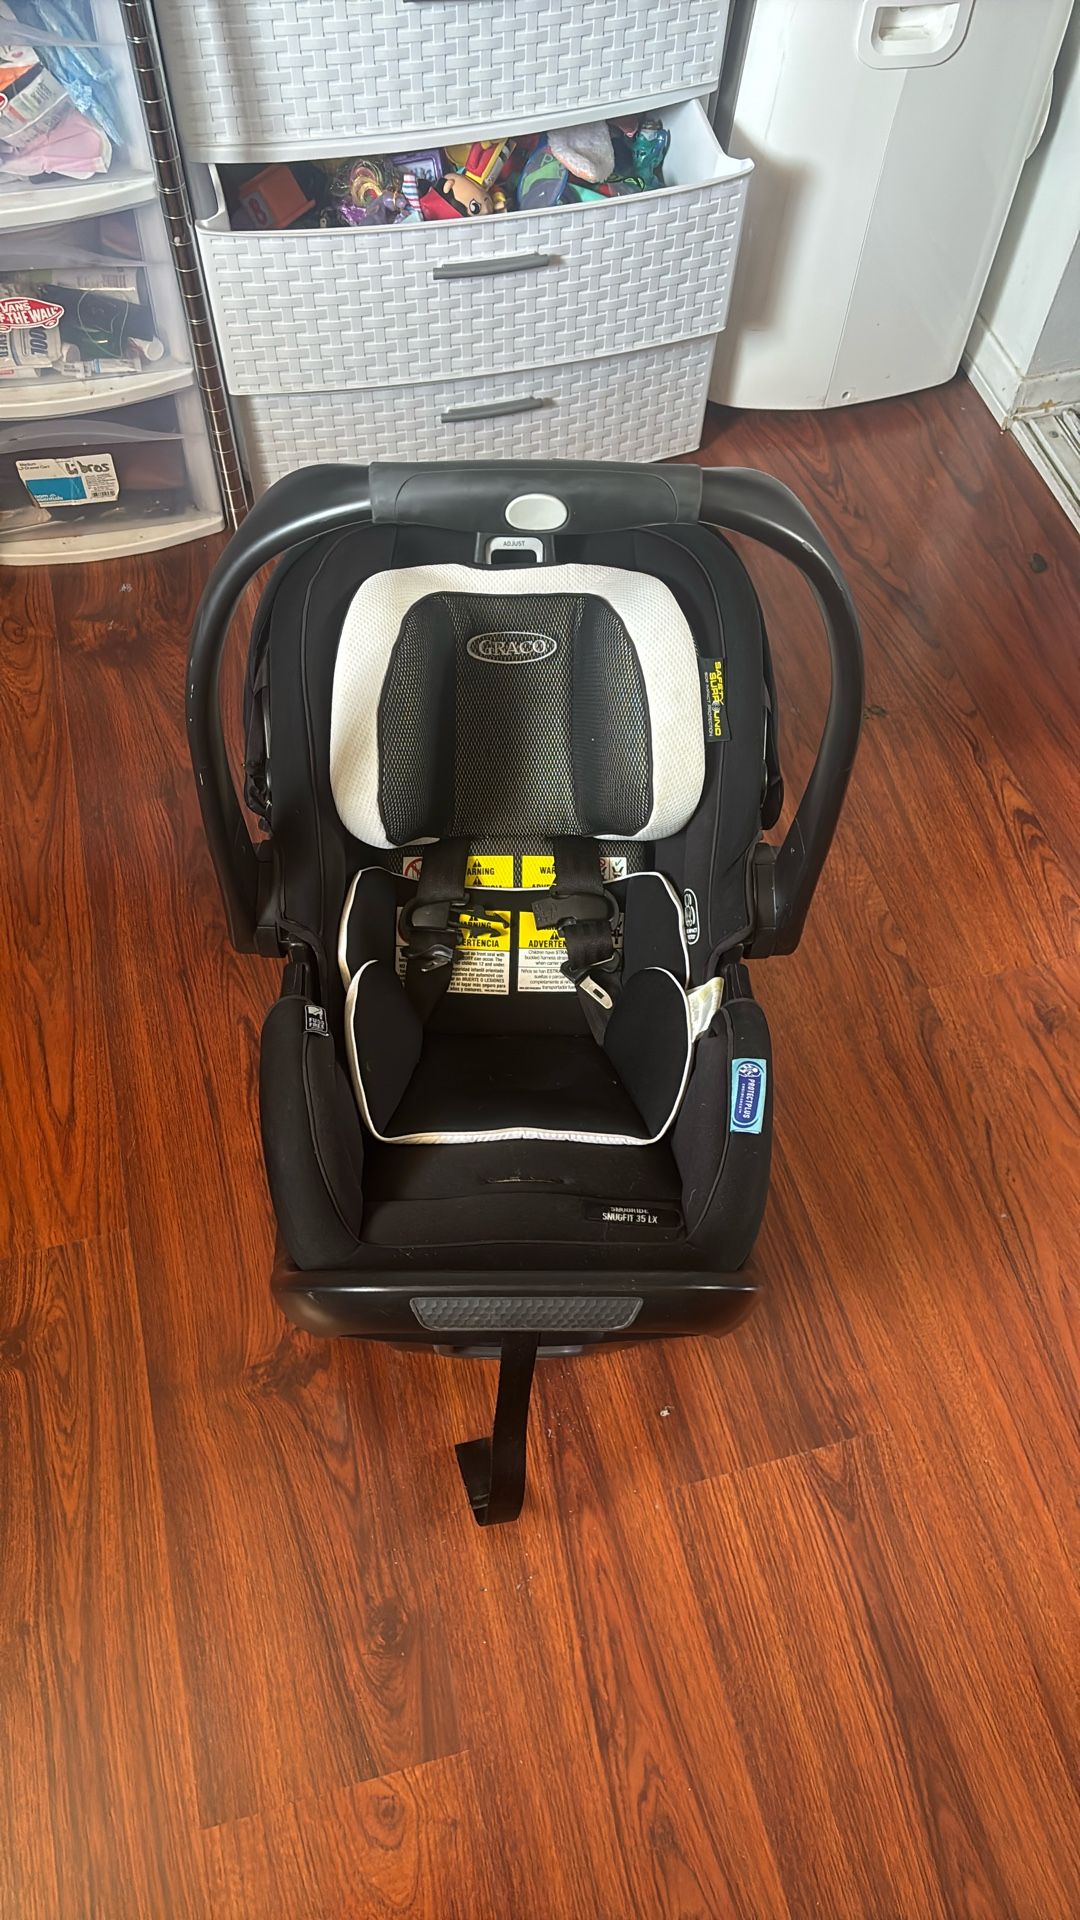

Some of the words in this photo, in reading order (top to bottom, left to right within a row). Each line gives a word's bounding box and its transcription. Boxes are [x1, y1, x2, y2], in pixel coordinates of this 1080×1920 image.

[0, 299, 31, 313] VANS
[5, 310, 31, 324] THE
[479, 639, 547, 656] GRACO
[714, 661, 725, 706] SAFETY
[466, 867, 495, 876] ARNING
[462, 921, 492, 929] ARNING
[463, 939, 500, 948] ERTENCIA
[528, 939, 568, 948] ADVERTEN
[742, 1078, 756, 1119] PROTECTPLUS
[602, 1212, 635, 1222] SNUGFIT
[636, 1214, 646, 1223] 35
[648, 1215, 658, 1224] LX
